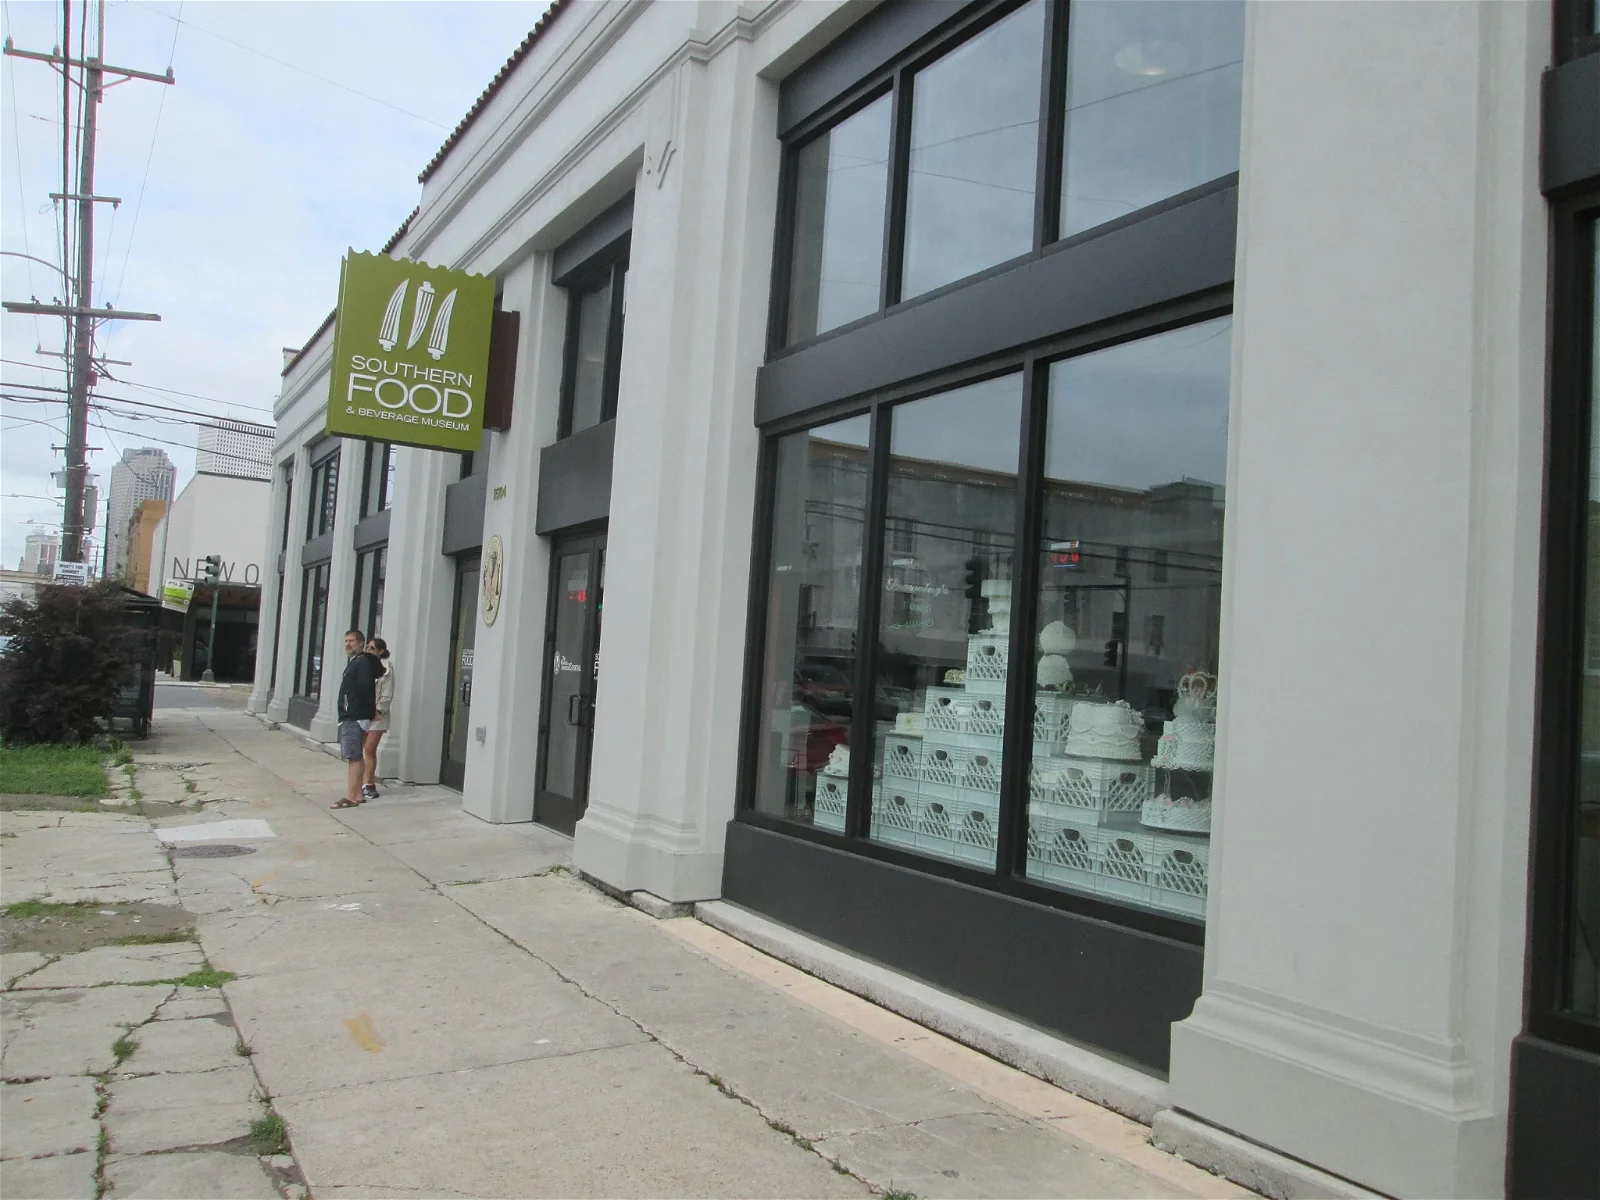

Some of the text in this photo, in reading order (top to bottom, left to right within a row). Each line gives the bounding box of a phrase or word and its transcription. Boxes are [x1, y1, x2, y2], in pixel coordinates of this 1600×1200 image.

[351, 355, 473, 388] SOUTHERN
[347, 372, 473, 418] FOOD
[346, 405, 470, 432] & BEVERAGE MUSEUM
